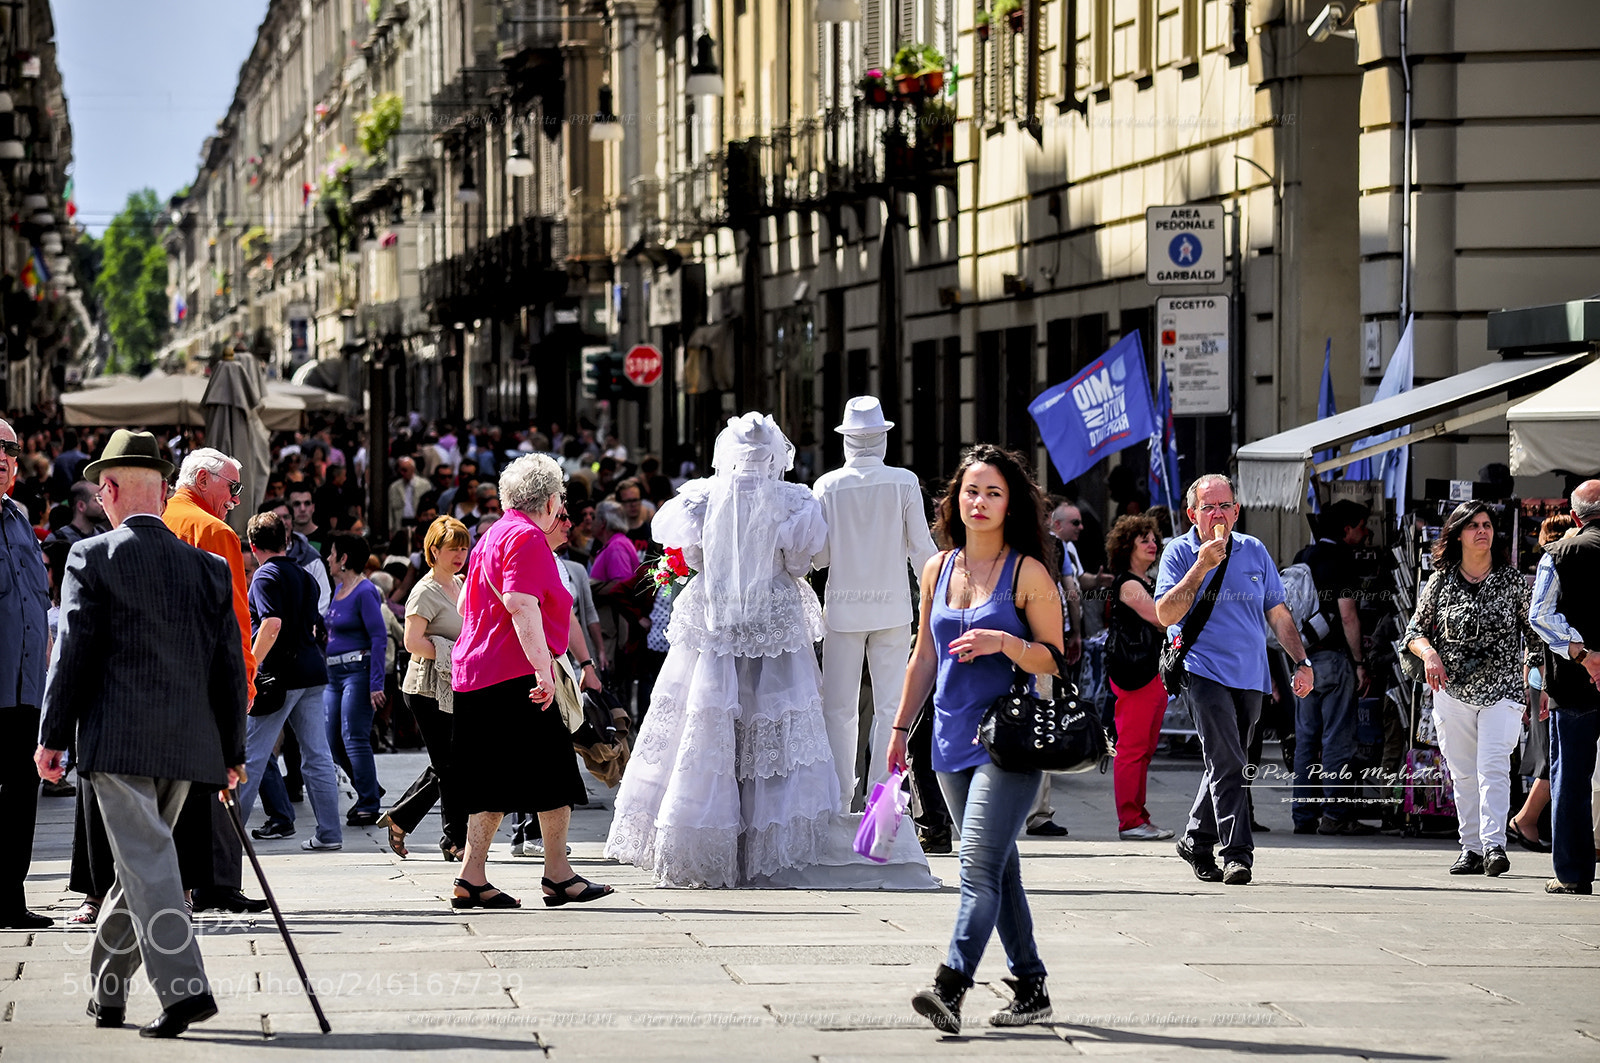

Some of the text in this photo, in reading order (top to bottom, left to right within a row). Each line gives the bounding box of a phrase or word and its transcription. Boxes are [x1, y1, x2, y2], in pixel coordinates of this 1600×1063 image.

[1171, 209, 1200, 219] AREA
[1155, 219, 1216, 231] PEDONALE
[1156, 270, 1216, 280] GARIBALDI
[625, 357, 660, 372] STOP
